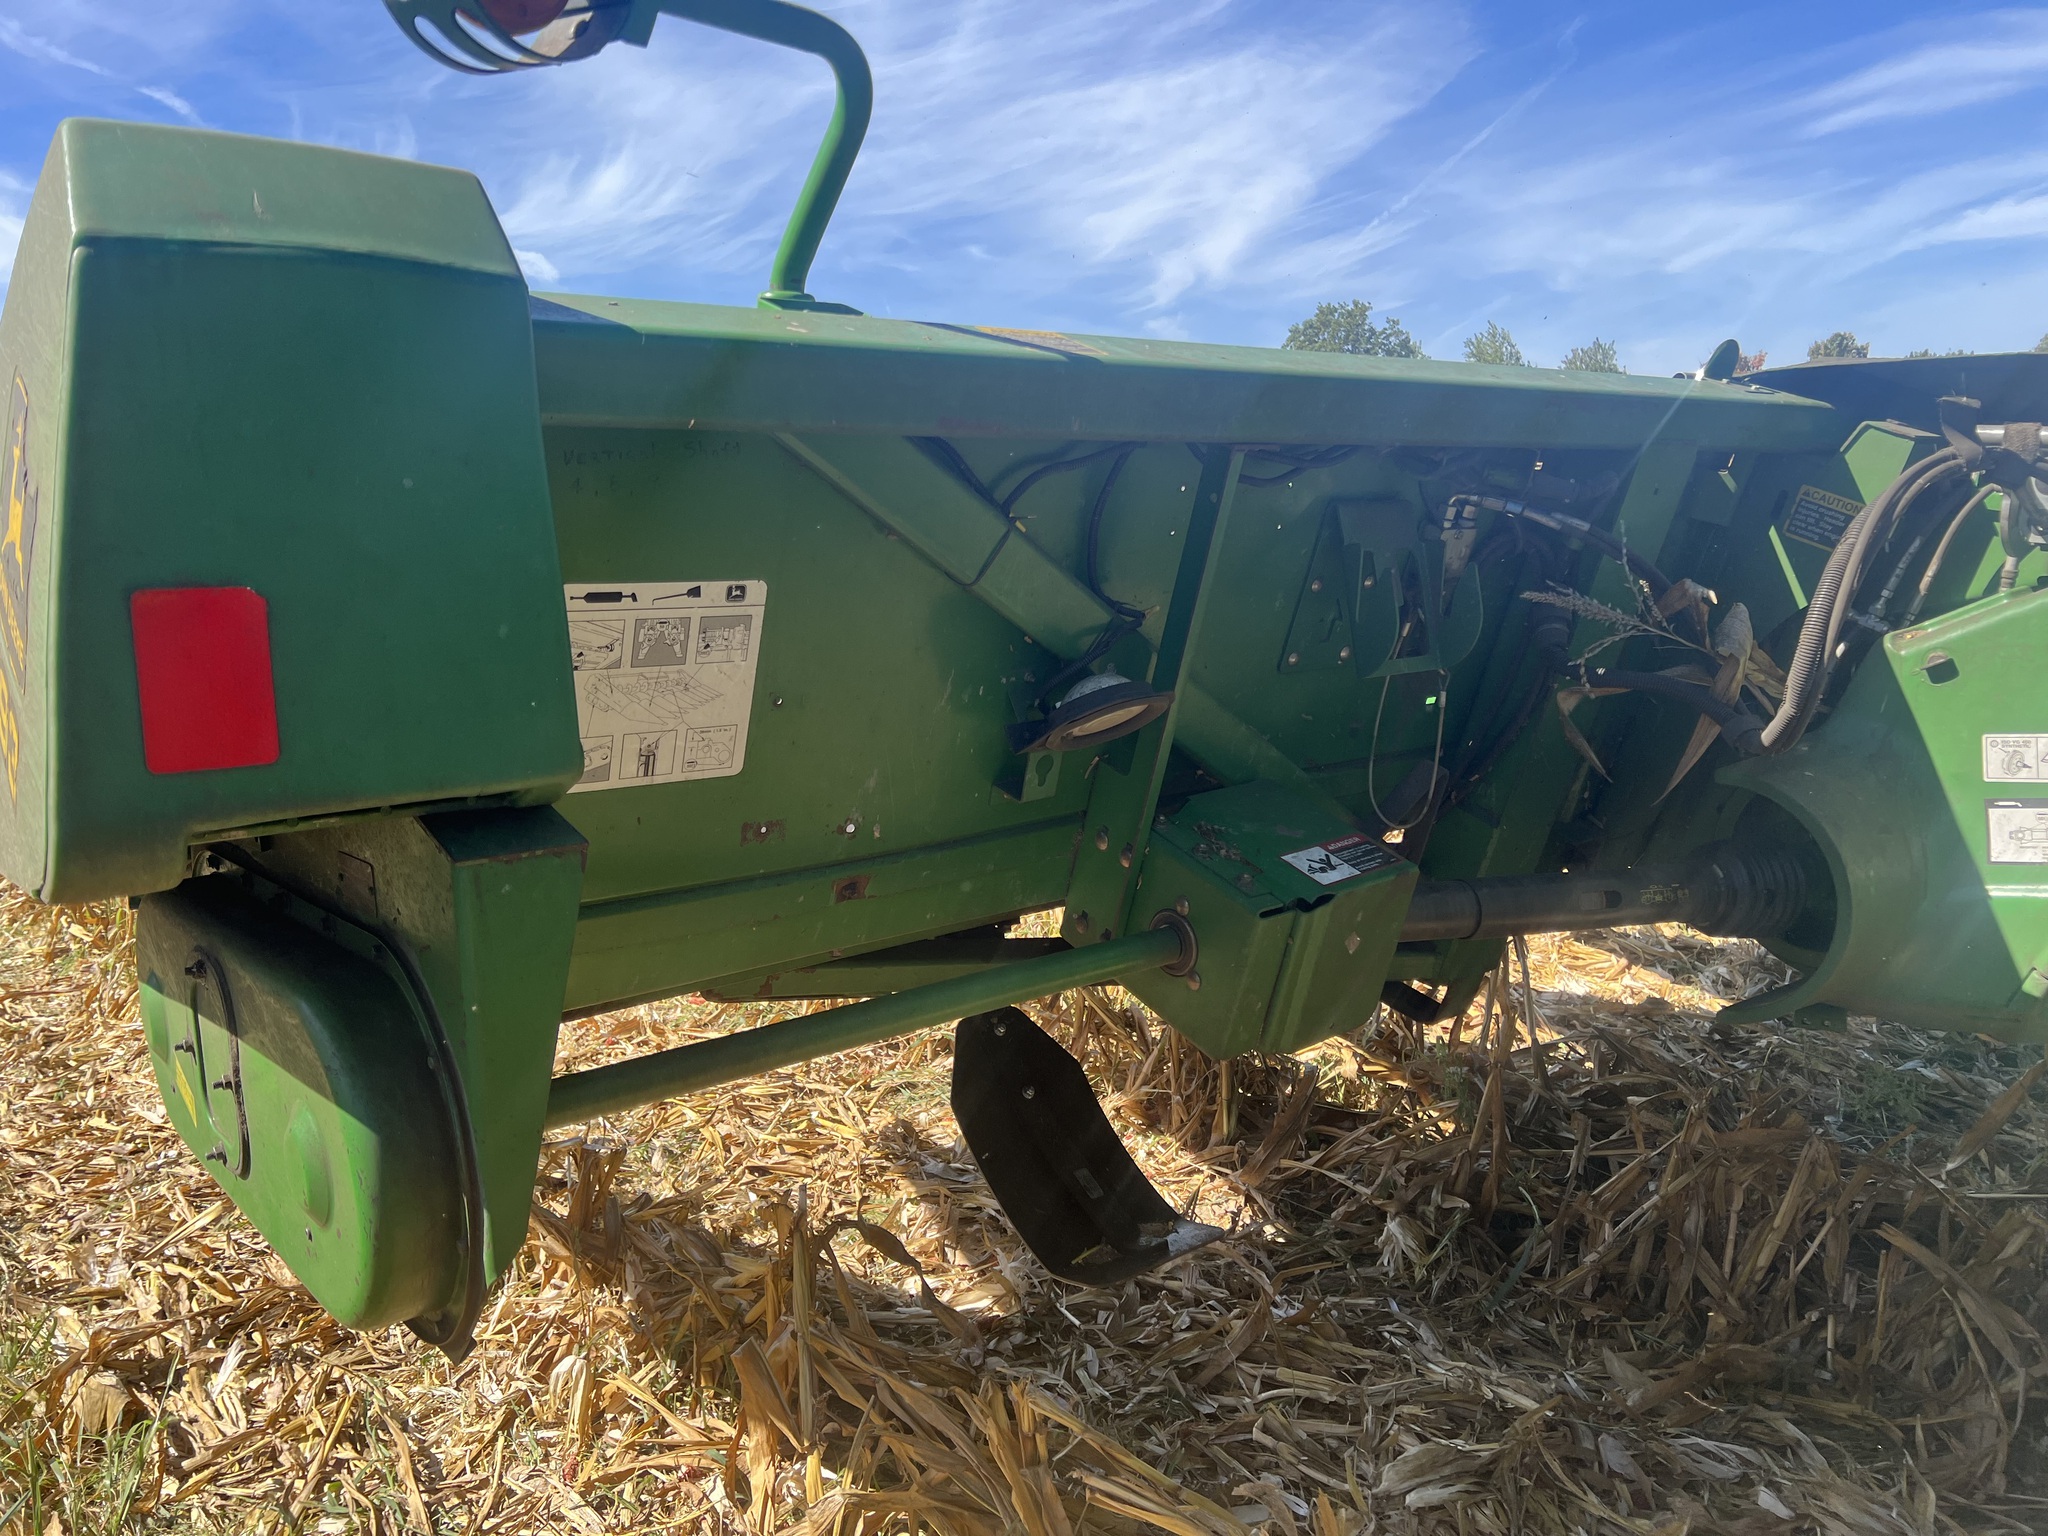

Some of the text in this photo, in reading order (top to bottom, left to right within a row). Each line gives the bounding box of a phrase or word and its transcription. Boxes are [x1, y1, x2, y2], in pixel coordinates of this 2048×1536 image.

[1800, 500, 1846, 522] Avoid crushing
[1811, 490, 1863, 514] CAUTION
